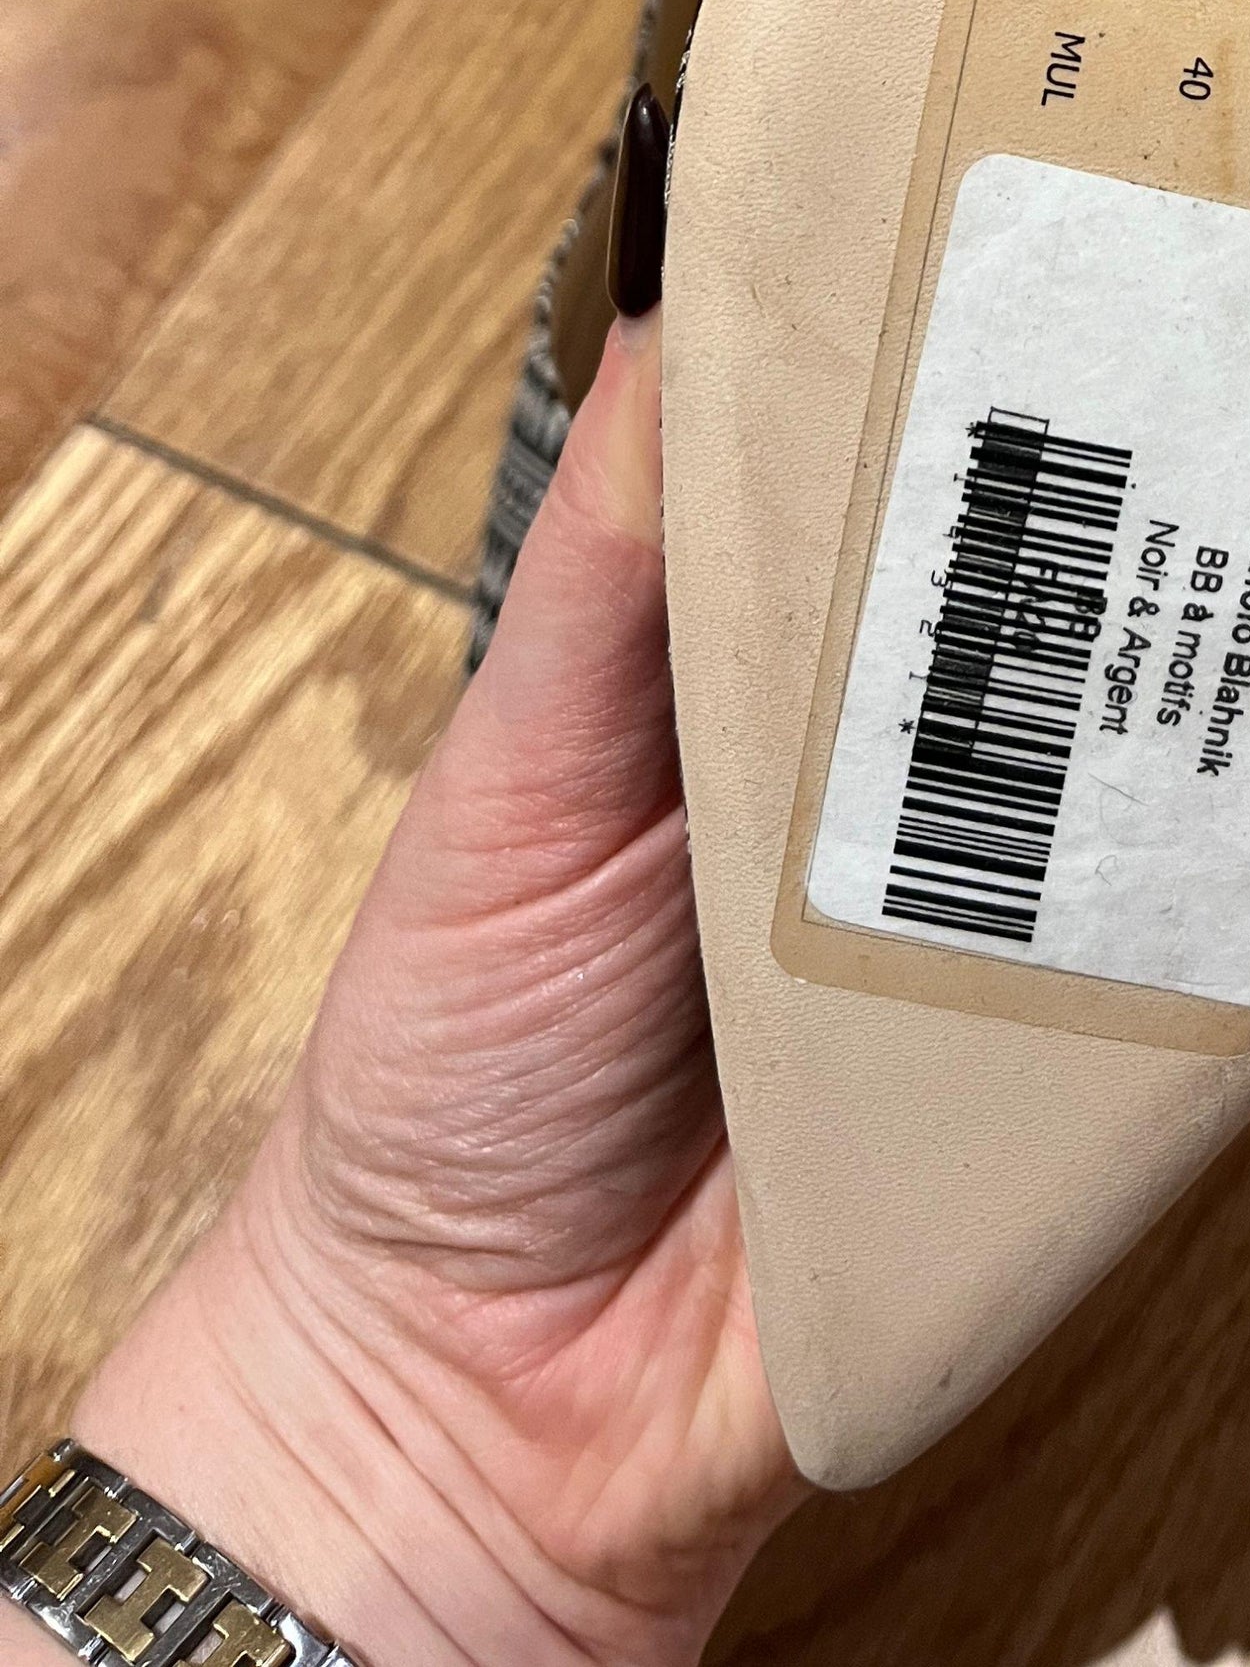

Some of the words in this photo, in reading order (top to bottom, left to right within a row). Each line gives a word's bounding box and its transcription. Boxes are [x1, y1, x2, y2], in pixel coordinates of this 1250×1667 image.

[1040, 31, 1086, 107] MUL
[1178, 56, 1214, 101] 40
[1137, 519, 1181, 591] Noir
[1190, 545, 1230, 594] BB
[1127, 595, 1160, 618] &
[1181, 601, 1214, 622] à
[1100, 626, 1152, 735] Argent
[1156, 629, 1202, 728] motifs
